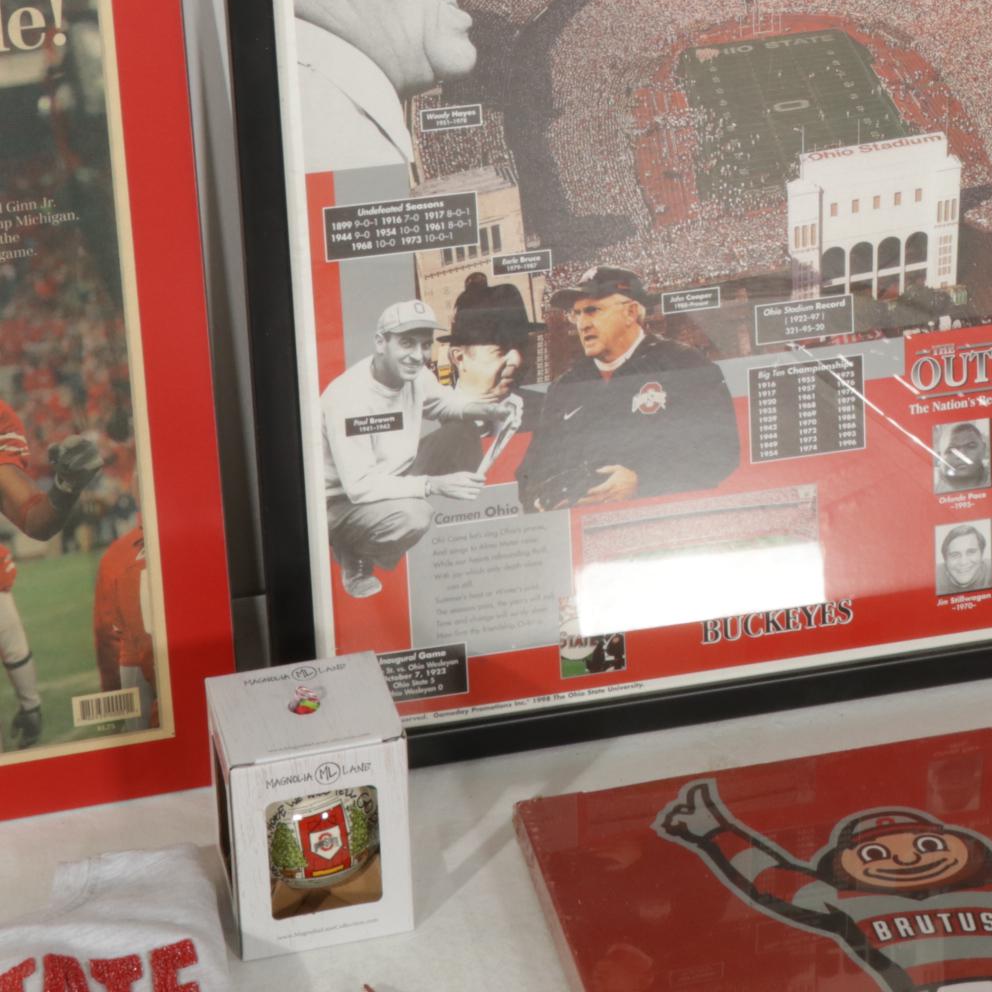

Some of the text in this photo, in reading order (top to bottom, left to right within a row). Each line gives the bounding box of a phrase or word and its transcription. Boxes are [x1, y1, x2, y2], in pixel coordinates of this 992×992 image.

[808, 134, 941, 161] Ohio Stadium
[6, 197, 56, 212] Ginn Jr.
[358, 200, 444, 217] Undefeated Seasons
[16, 211, 79, 225] Michigan.
[332, 221, 352, 231] 1899
[382, 216, 401, 224] 1916
[425, 211, 444, 220] 1917
[331, 233, 352, 242] 1944
[376, 228, 396, 237] 1954
[425, 223, 445, 232] 1961
[352, 241, 372, 251] 1968
[401, 236, 421, 245] 1973
[784, 304, 814, 314] Stadium
[816, 300, 845, 311] Record
[758, 370, 770, 381] Big
[787, 360, 854, 376] Championships
[909, 404, 929, 415] The
[933, 398, 975, 413] Nation's
[434, 505, 519, 525] Carmen Ohio
[701, 598, 854, 645] BUCKEYES
[419, 650, 446, 660] Game
[408, 664, 424, 672] Ohio
[427, 659, 459, 669] Wesleyan
[426, 668, 446, 676] 1922
[244, 675, 289, 685] MAGNOLIA
[393, 681, 410, 689] Ohio
[433, 708, 469, 718] Gameday
[472, 703, 512, 713] Promotions
[266, 763, 371, 789] MAGNOLIA LAND
